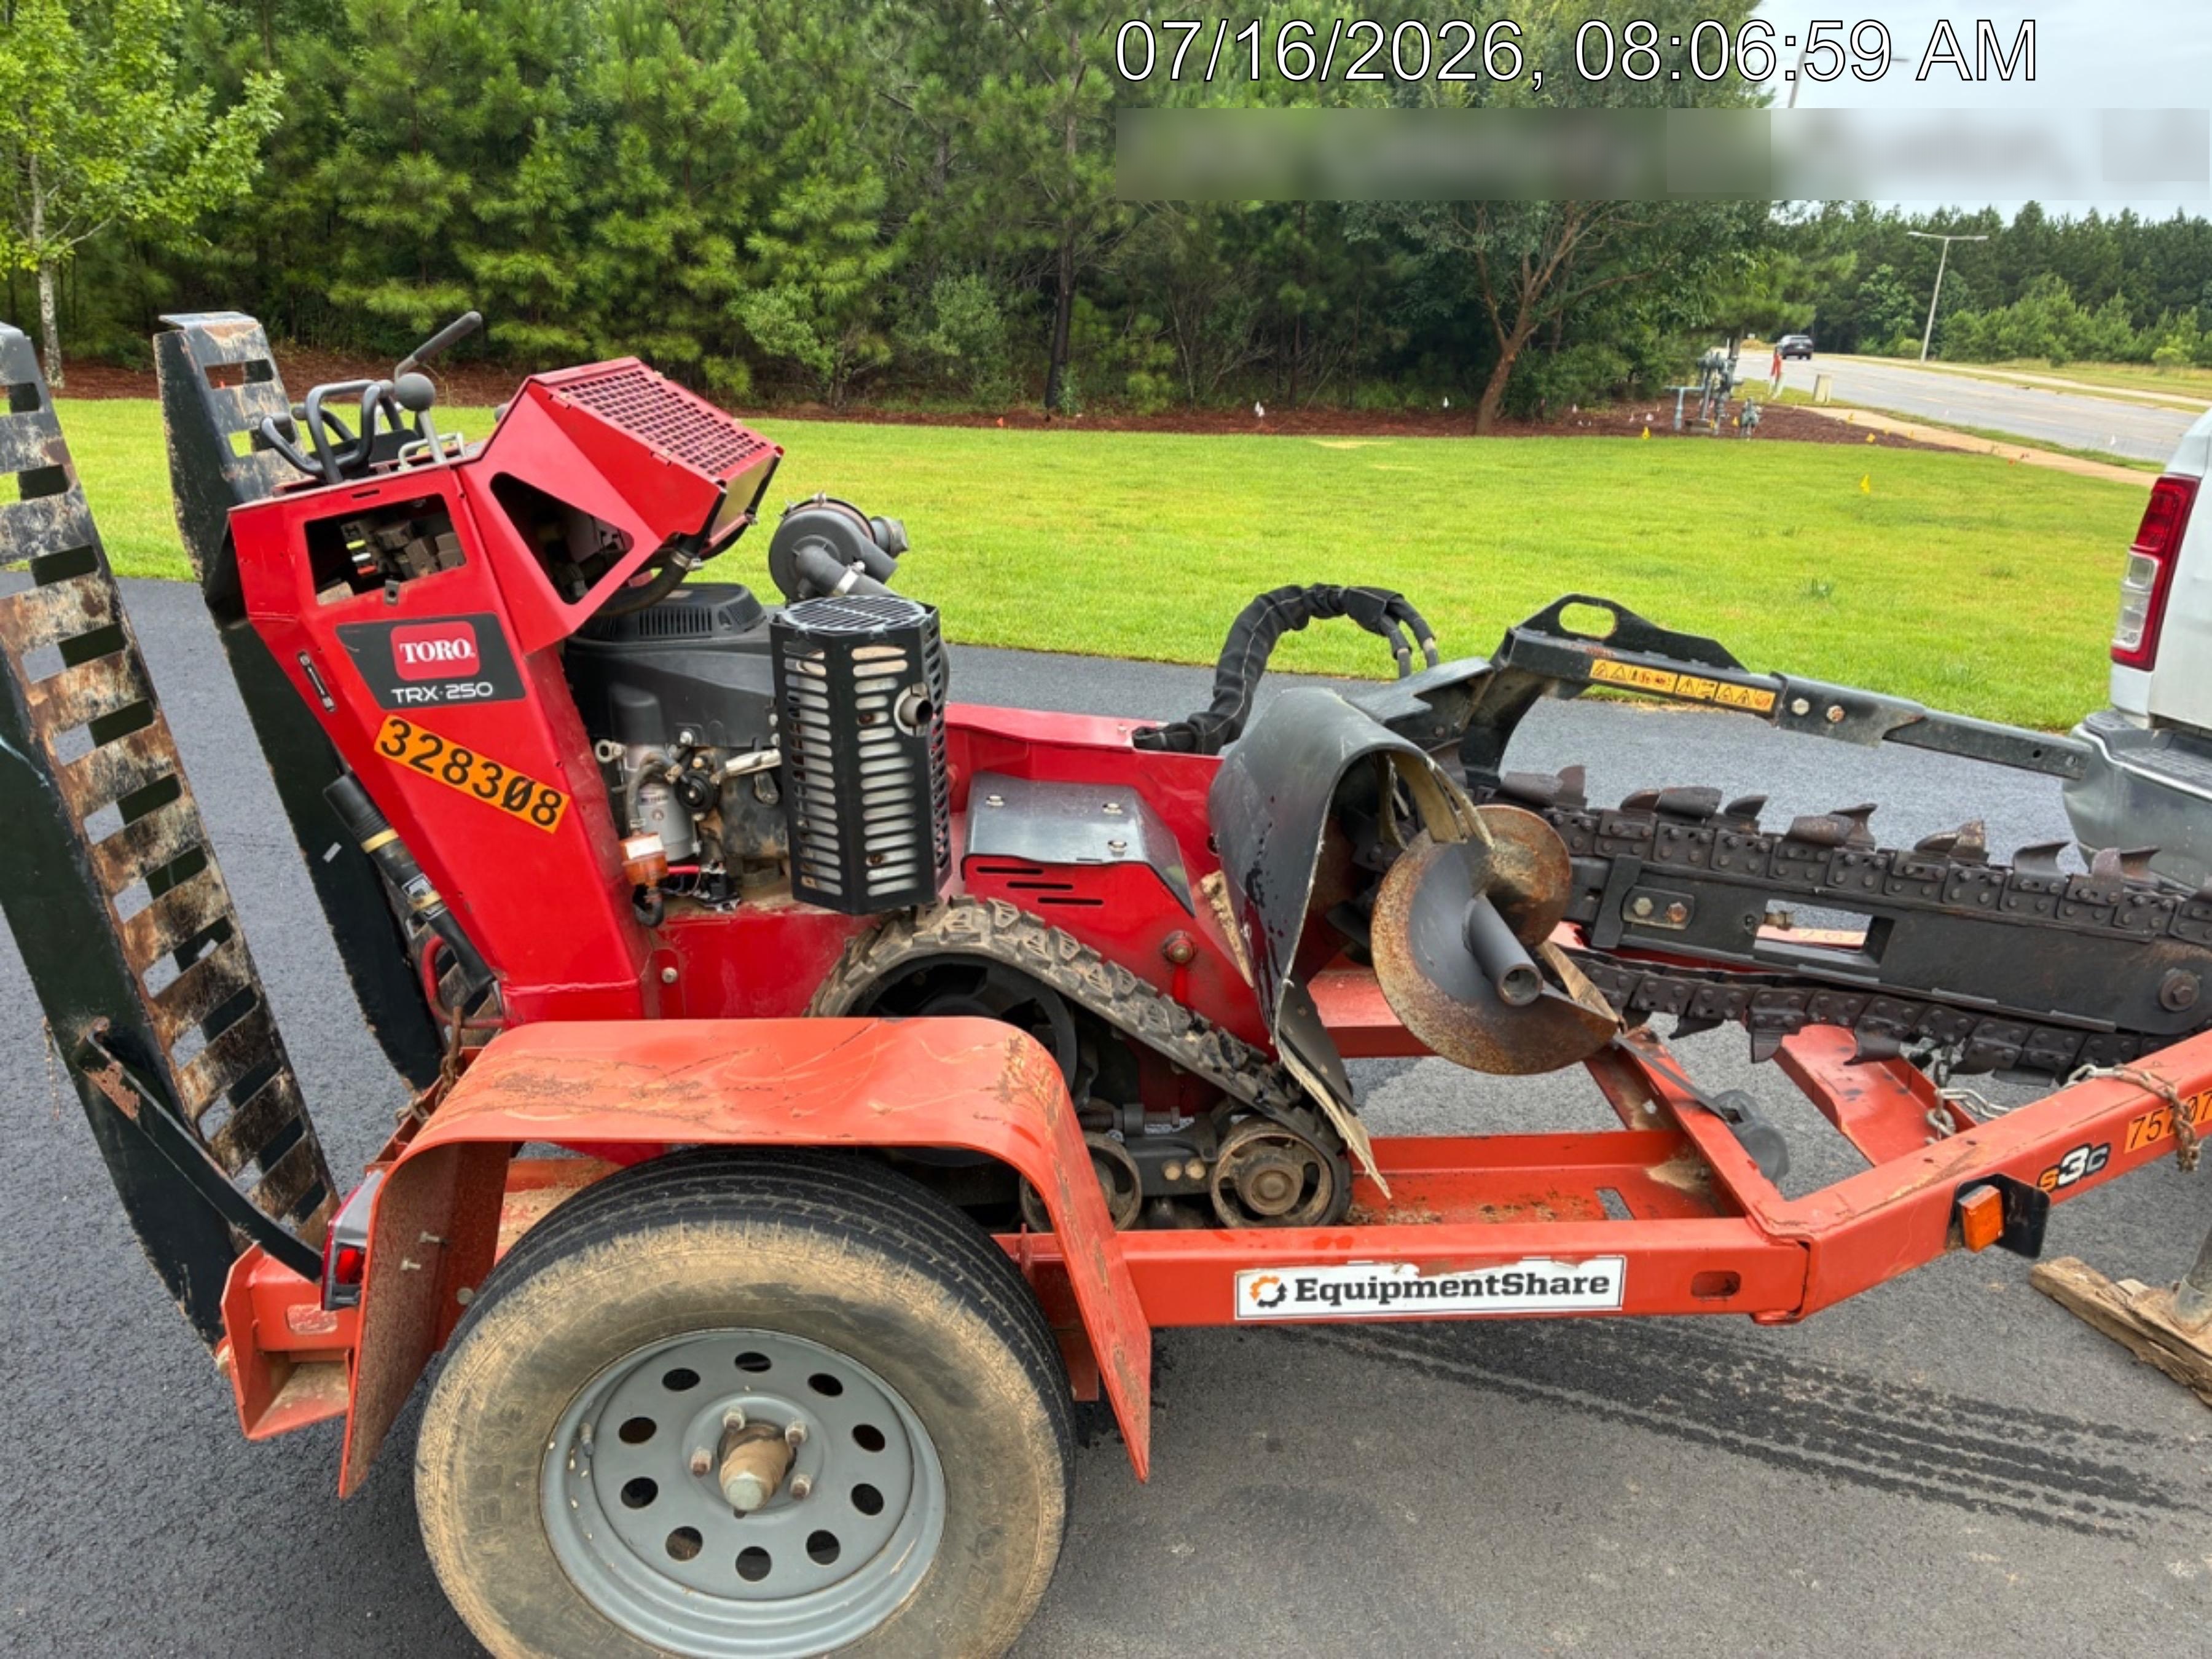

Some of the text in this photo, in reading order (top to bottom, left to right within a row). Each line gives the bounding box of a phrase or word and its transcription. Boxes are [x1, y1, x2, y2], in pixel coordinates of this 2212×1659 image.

[398, 637, 473, 664] TORO
[380, 718, 563, 826] 328308
[1294, 1273, 1610, 1306] EquipmentShare
